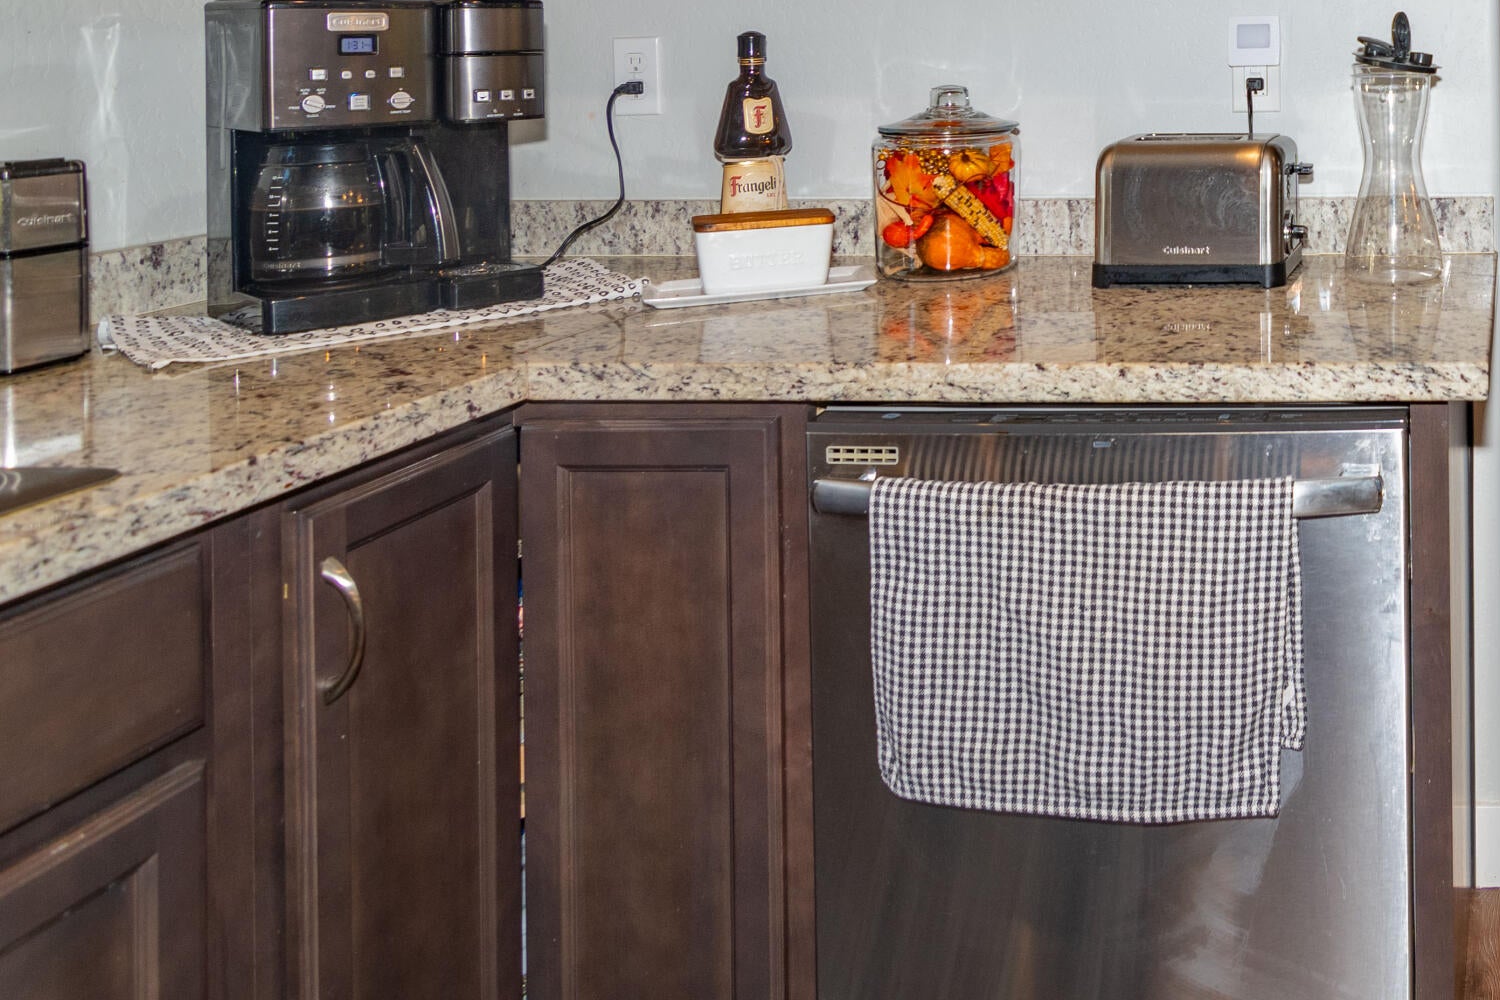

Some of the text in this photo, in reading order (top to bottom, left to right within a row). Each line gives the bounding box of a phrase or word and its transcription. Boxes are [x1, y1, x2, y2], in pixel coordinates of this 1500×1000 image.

[753, 105, 767, 128] F
[729, 175, 777, 197] Frangeli
[1163, 246, 1210, 255] Cuisinart
